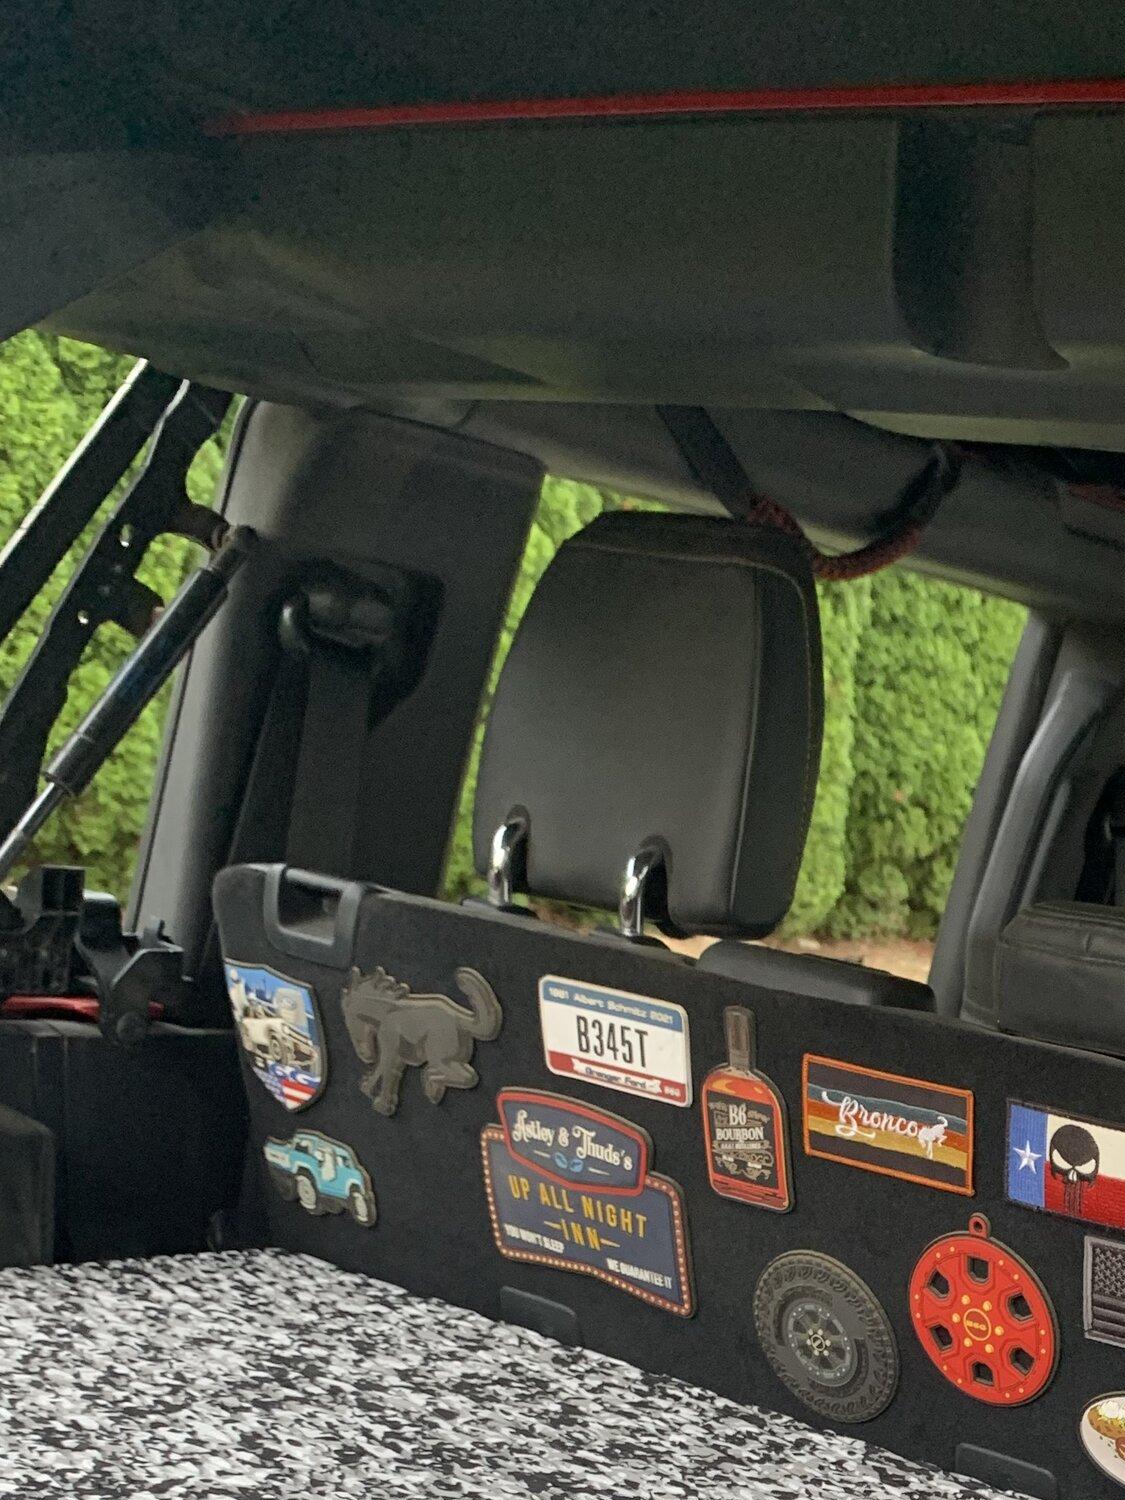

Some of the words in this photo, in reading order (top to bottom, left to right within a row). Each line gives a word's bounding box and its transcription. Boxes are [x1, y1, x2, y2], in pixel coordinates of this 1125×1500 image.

[576, 1014, 649, 1069] B345T
[715, 1126, 765, 1142] BOURBON
[728, 1102, 747, 1127] B6
[822, 1090, 919, 1140] Bronco
[511, 1108, 556, 1147] Astley
[557, 1126, 570, 1148] &
[572, 1124, 633, 1171] Thuds's
[508, 1173, 531, 1201] UP
[538, 1181, 575, 1214] ALL
[580, 1194, 648, 1239] NIGHT
[560, 1218, 601, 1252] INN
[606, 1257, 621, 1273] WE
[620, 1261, 665, 1288] GUARANTEE
[663, 1274, 673, 1290] IT
